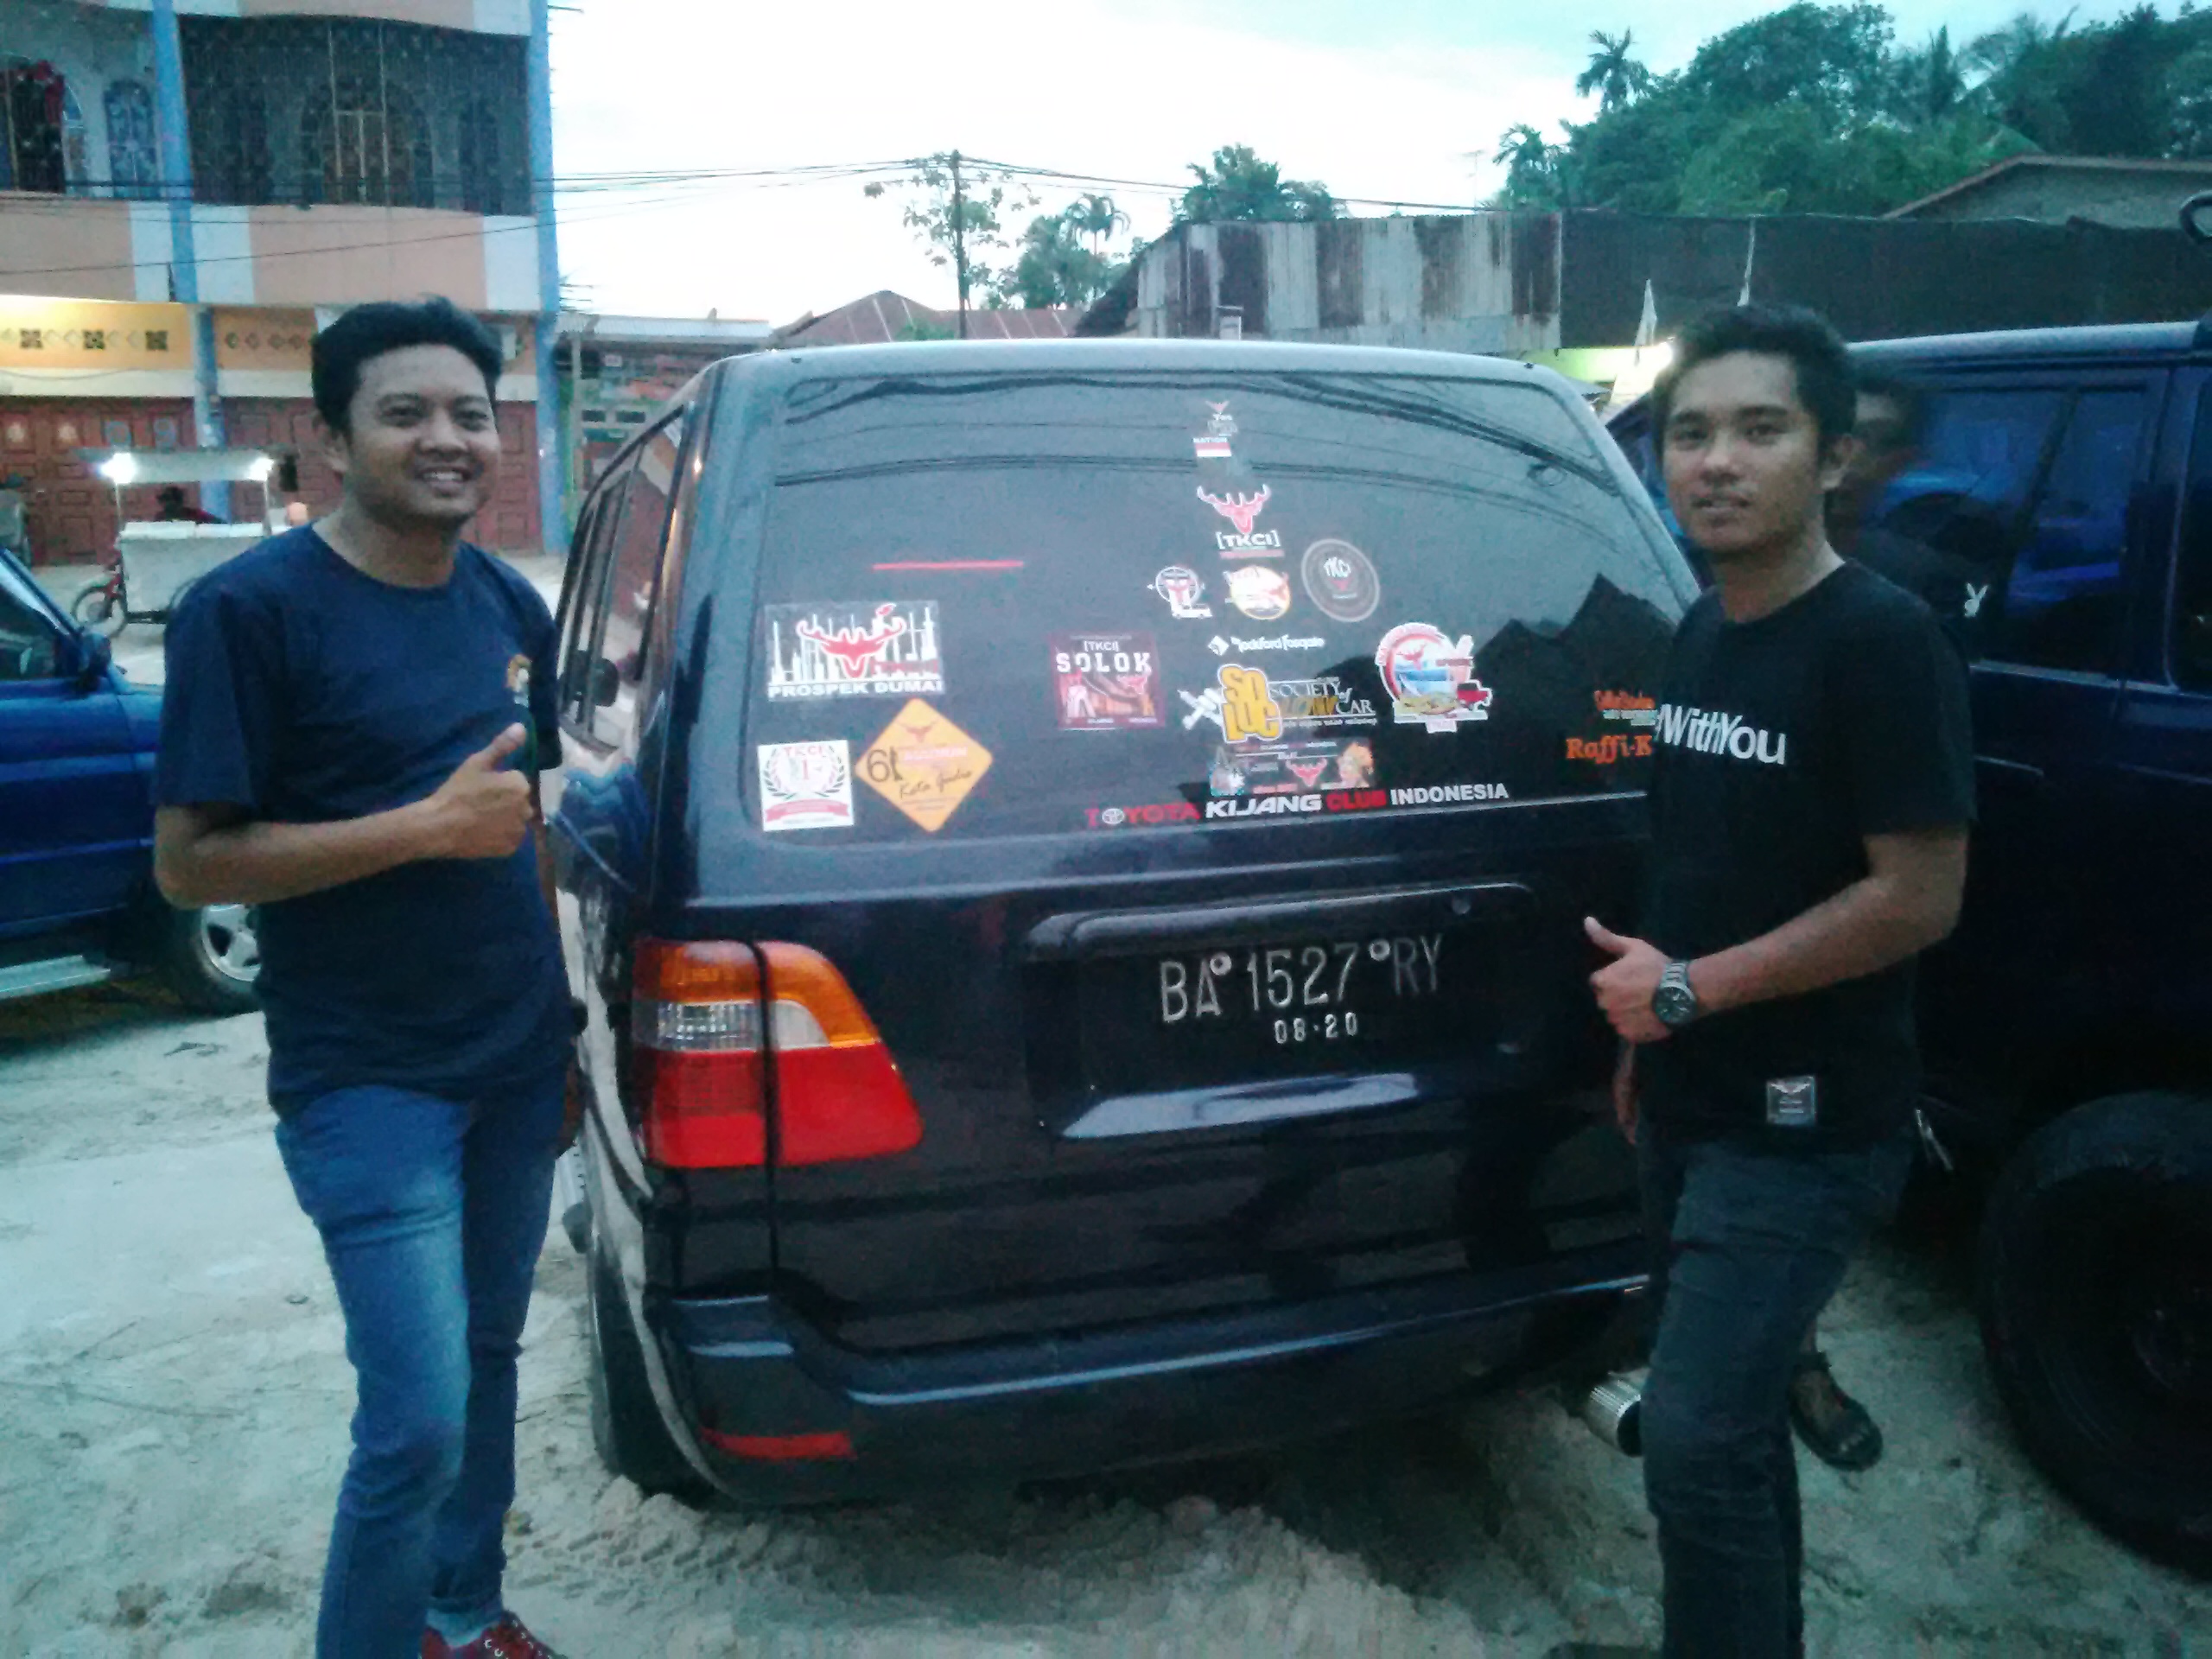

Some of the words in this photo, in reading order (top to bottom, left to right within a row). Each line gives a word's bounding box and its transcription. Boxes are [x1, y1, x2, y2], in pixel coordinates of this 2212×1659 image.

[1056, 652, 1152, 672] SOLOK
[1205, 794, 1323, 818] KIJANG
[1326, 789, 1387, 811] CLUB
[1390, 783, 1510, 805] INDONESIA
[1160, 960, 1223, 1023] BA
[1247, 941, 1359, 1012] 1527
[1392, 933, 1443, 995] RY
